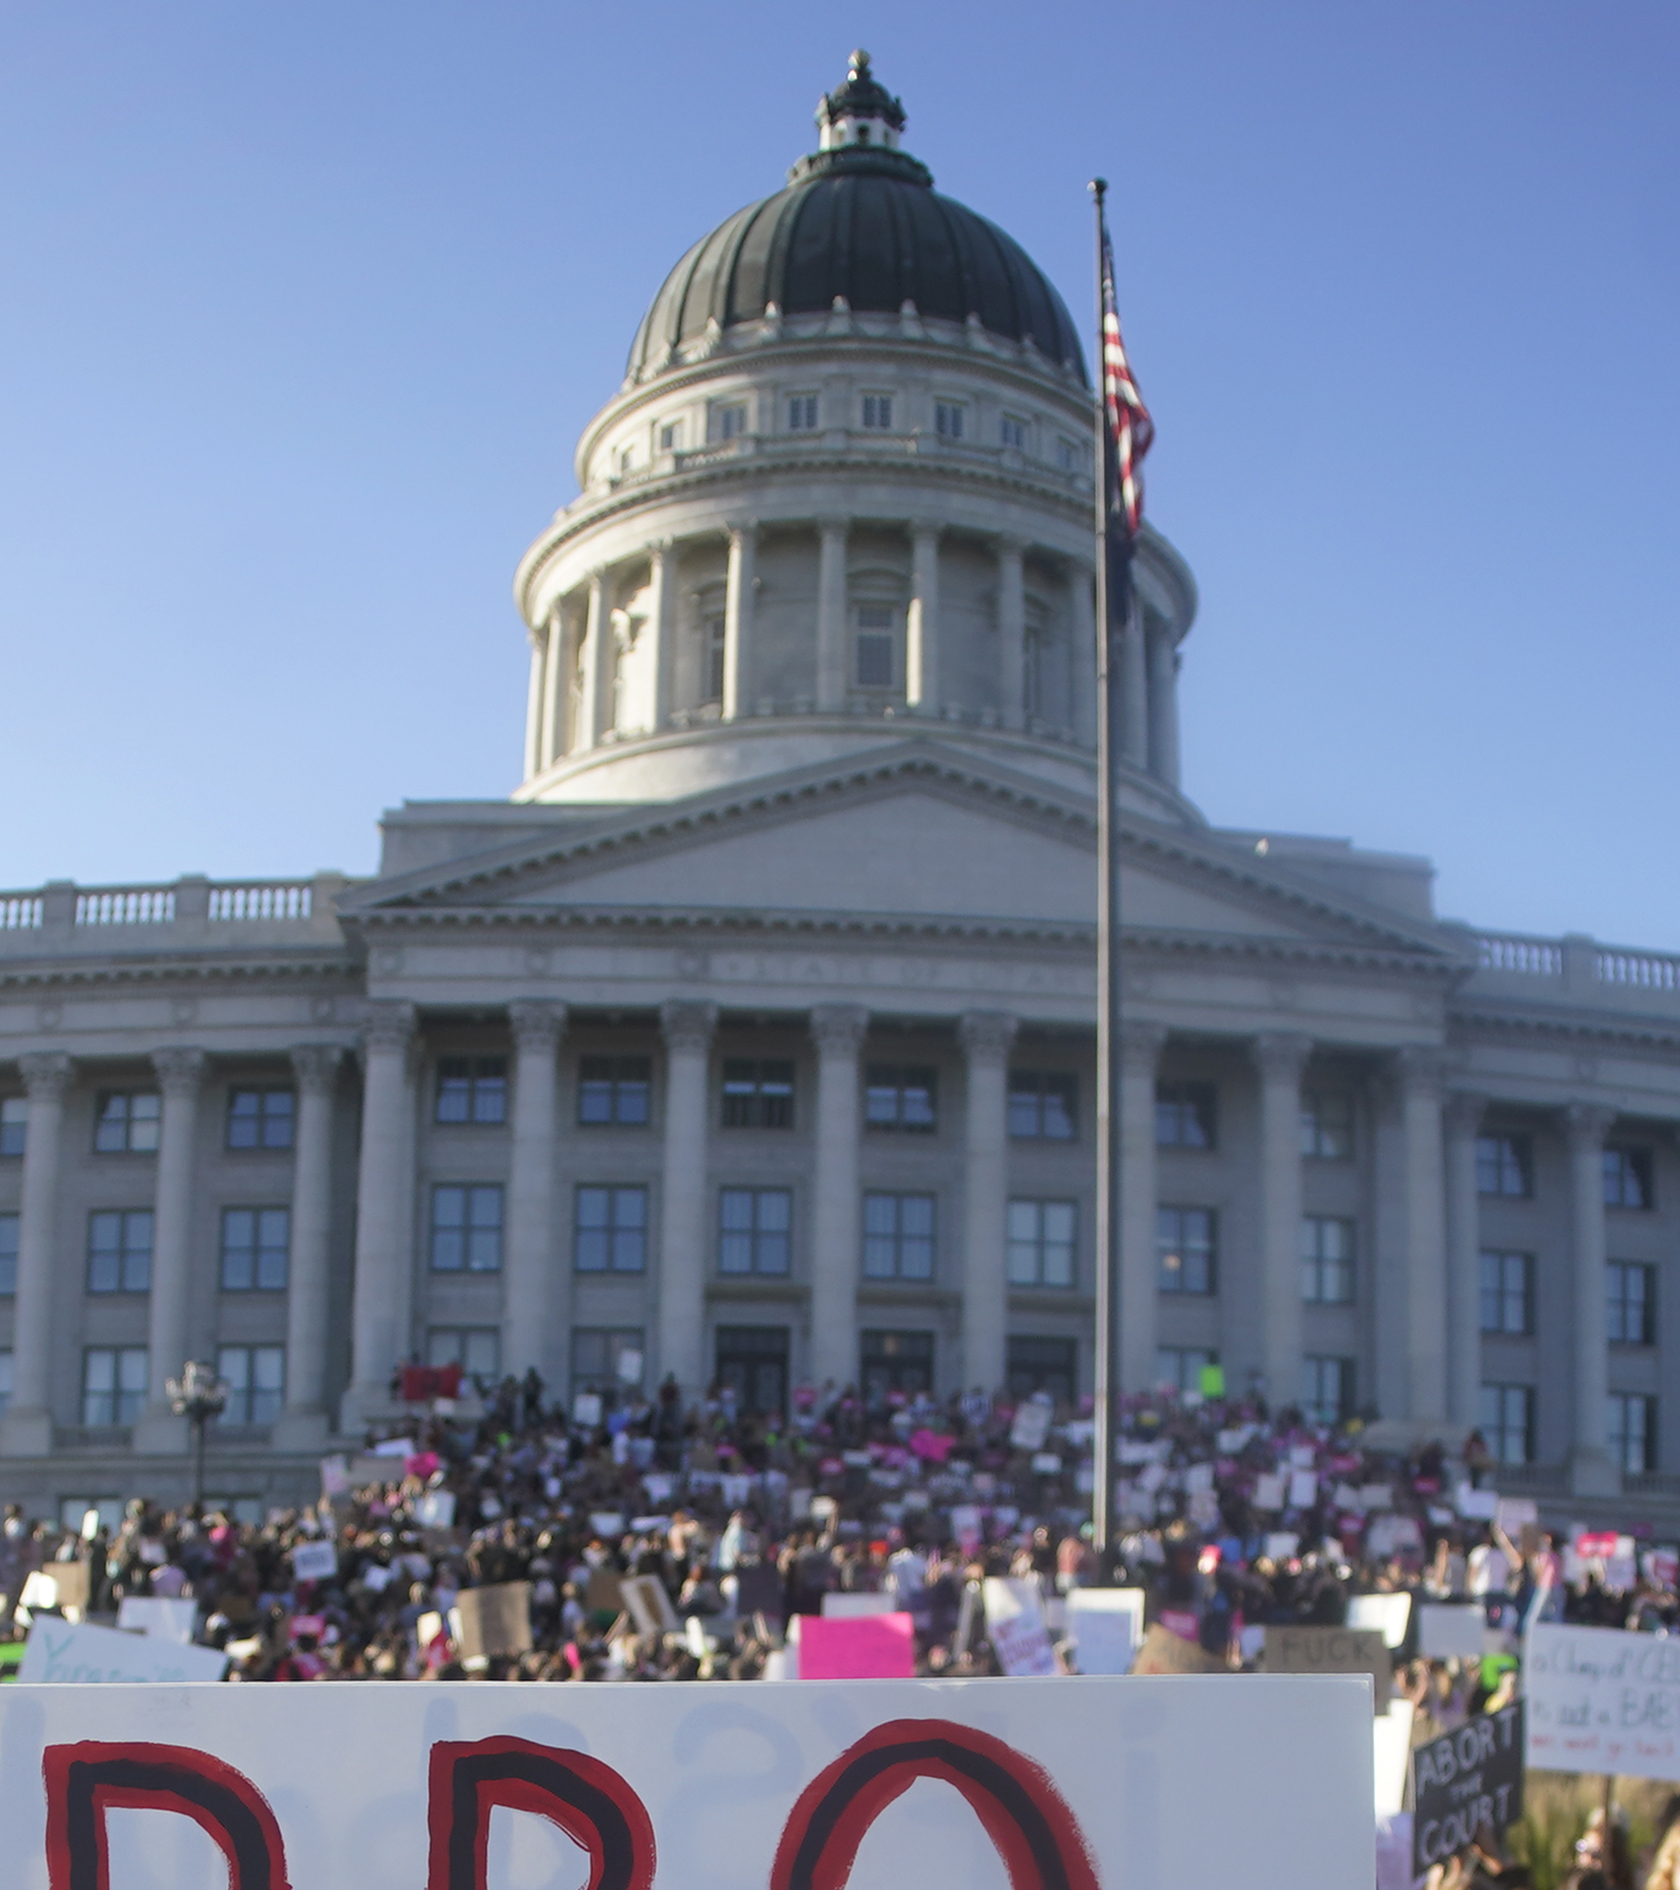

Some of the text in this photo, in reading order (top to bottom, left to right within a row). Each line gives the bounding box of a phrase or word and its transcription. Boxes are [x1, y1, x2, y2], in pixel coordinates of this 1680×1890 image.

[1282, 1632, 1374, 1666] FUCK
[1416, 1708, 1517, 1793] ABORT
[1449, 1773, 1482, 1800] THE
[1420, 1785, 1512, 1863] COURT
